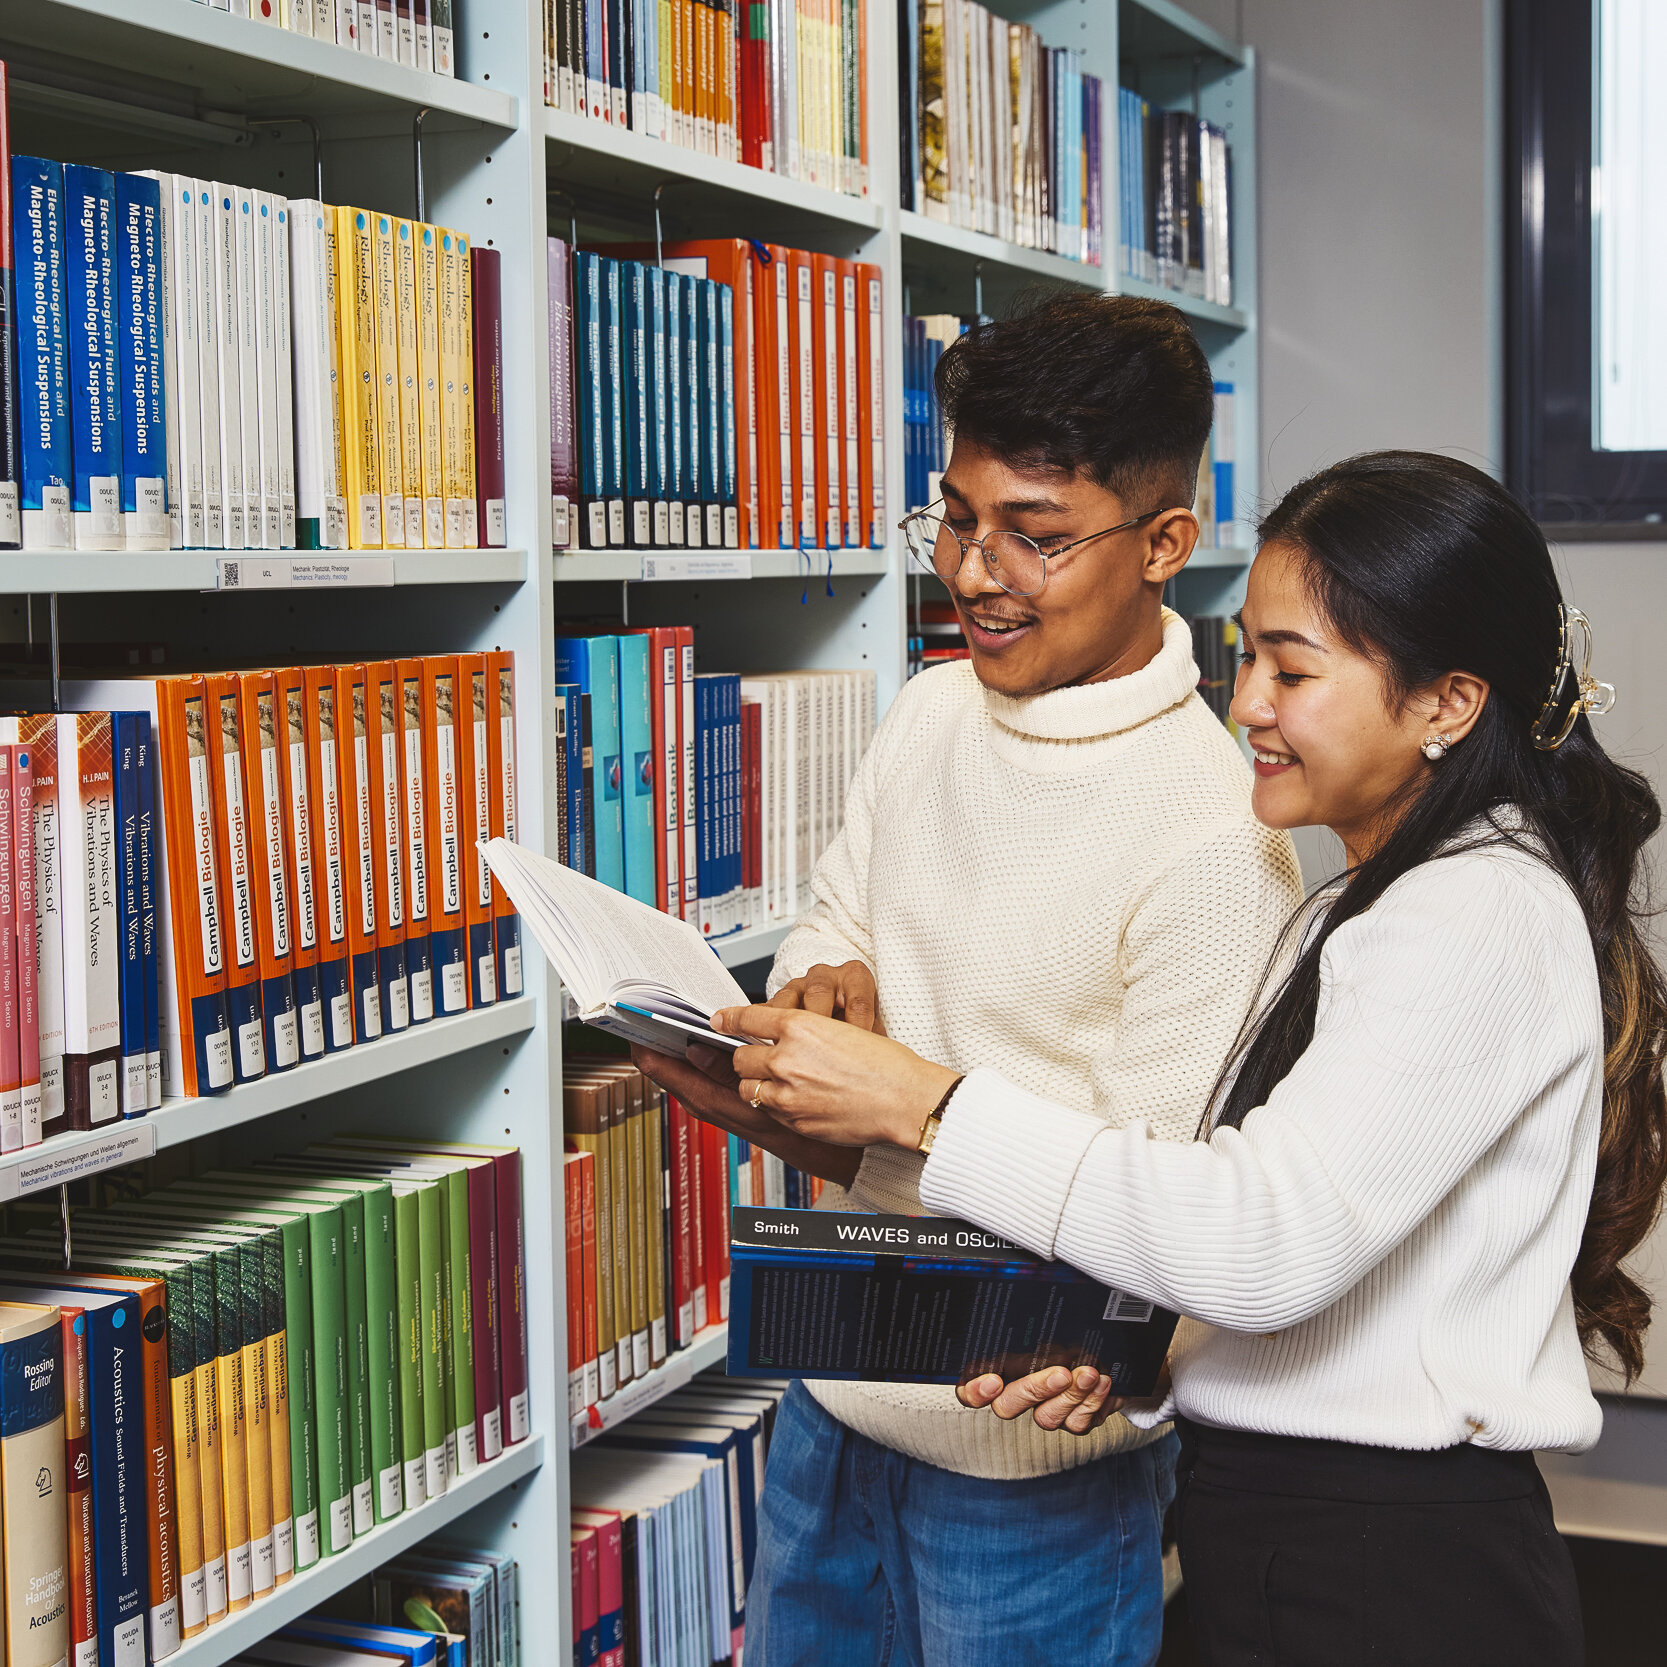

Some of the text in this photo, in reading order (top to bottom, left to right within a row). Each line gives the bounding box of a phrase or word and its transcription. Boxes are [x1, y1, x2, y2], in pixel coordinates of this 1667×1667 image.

[47, 188, 65, 417] Electro-Rheological Fluids and
[360, 235, 371, 306] Rheology
[382, 240, 392, 309] Rheology
[403, 245, 412, 313] Rheology
[426, 249, 435, 316] Rheology
[445, 254, 454, 320] Rheology
[28, 185, 53, 449] Magneto-Rheological Suspensions
[81, 195, 103, 453] Magneto-Rheological Suspensions
[100, 198, 116, 421] Electro-Rheological Fluids and
[126, 202, 149, 454] Magneto-Rheological Suspensions
[144, 205, 160, 423] Electro-Rheological Fluids and
[555, 300, 565, 444] Electromagnetics
[592, 322, 600, 386] Electricity
[49, 475, 63, 486] Tao
[594, 417, 603, 487] Magnetism
[37, 776, 53, 786] PAIN
[123, 747, 131, 770] King
[138, 745, 146, 767] King
[505, 762, 513, 822] Biologie
[668, 744, 677, 825] Botanik
[686, 741, 696, 821] Botanik
[0, 788, 10, 914] Schwingungen
[18, 786, 31, 911] Schwingungen
[41, 800, 57, 914] The Physics of
[98, 794, 113, 908] The Physics of
[297, 794, 314, 941] Campbell Biologie
[327, 790, 343, 935] Campbell Biologie
[360, 786, 374, 928] Campbell Biologie
[387, 782, 400, 921] Campbell Biologie
[411, 777, 425, 914] Campbell Biologie
[443, 772, 457, 907] Campbell Biologie
[478, 768, 490, 900] Campll Biologie
[86, 797, 100, 967] Vibrations and Waves
[125, 814, 139, 961] Vibrations and Waves
[140, 811, 154, 955] Vibrations and Waves
[198, 811, 219, 967] Campbell Biologie
[232, 805, 251, 959] Campbell Biologie
[269, 800, 287, 950] Campbell Biologie
[4, 1001, 12, 1028] Sextro
[99, 1021, 119, 1033] EDITION
[20, 1136, 139, 1179] Mechanische Schwingungen und Wellen allgemein
[21, 1174, 50, 1188] Mechanical
[50, 1167, 73, 1180] vibrations
[74, 1163, 84, 1172] and
[84, 1159, 100, 1169] waves
[105, 1151, 124, 1164] general
[678, 1126, 690, 1235] MAGNETISM
[754, 1221, 1026, 1249] Smith WAVES and OSCIL
[24, 1358, 54, 1379] Rossing
[30, 1374, 52, 1392] Editor
[113, 1346, 125, 1424] Acoustics
[115, 1428, 124, 1460] Sound
[117, 1462, 125, 1494] Fields
[82, 1495, 91, 1534] Vibration
[152, 1445, 170, 1519] physical
[25, 1580, 65, 1606] Handbook
[29, 1566, 63, 1591] Springer
[84, 1553, 92, 1597] Structural
[118, 1589, 138, 1603] Beranek
[159, 1521, 171, 1602] acoustics
[29, 1602, 65, 1629] Acoustics
[45, 1594, 55, 1610] of
[119, 1600, 138, 1612] Mellow
